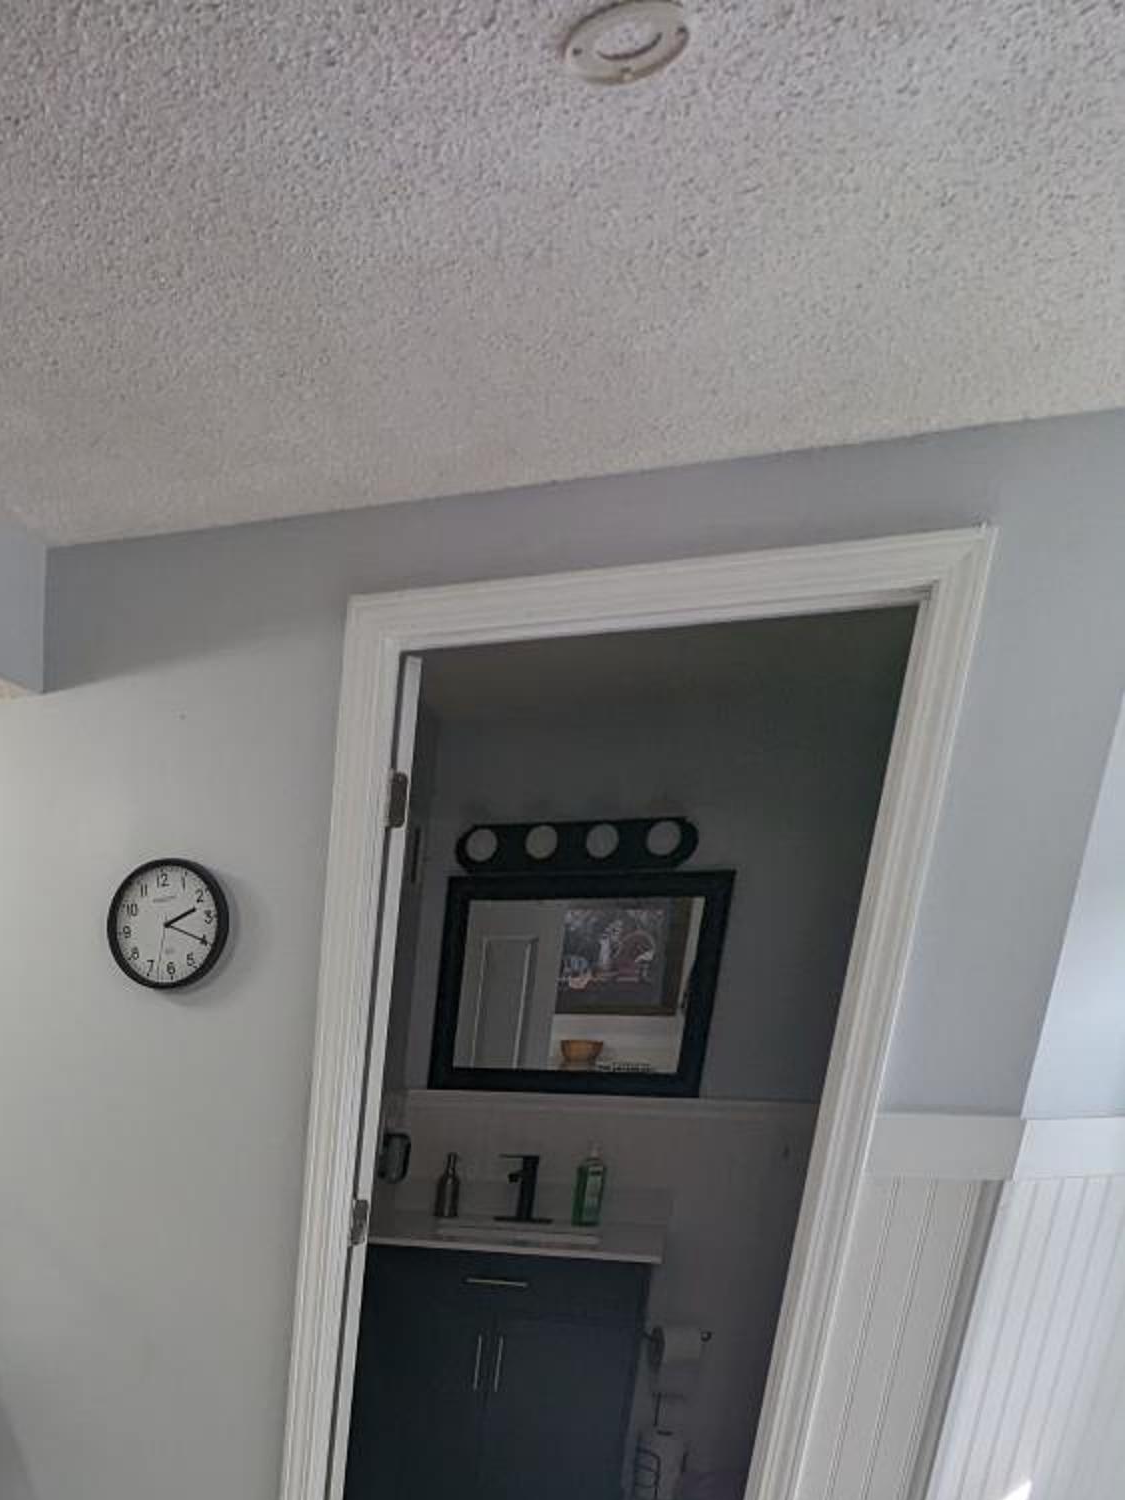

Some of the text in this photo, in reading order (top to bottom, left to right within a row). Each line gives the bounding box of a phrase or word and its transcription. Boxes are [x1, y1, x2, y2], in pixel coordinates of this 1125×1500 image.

[156, 873, 170, 888] 12
[140, 883, 148, 897] 11
[196, 888, 204, 903] 2
[126, 903, 138, 917] 10
[204, 909, 213, 925] 3
[122, 925, 132, 939] 9
[130, 947, 140, 961] 8
[186, 952, 195, 967] 5
[147, 959, 155, 974] 7
[166, 961, 176, 975] 6
